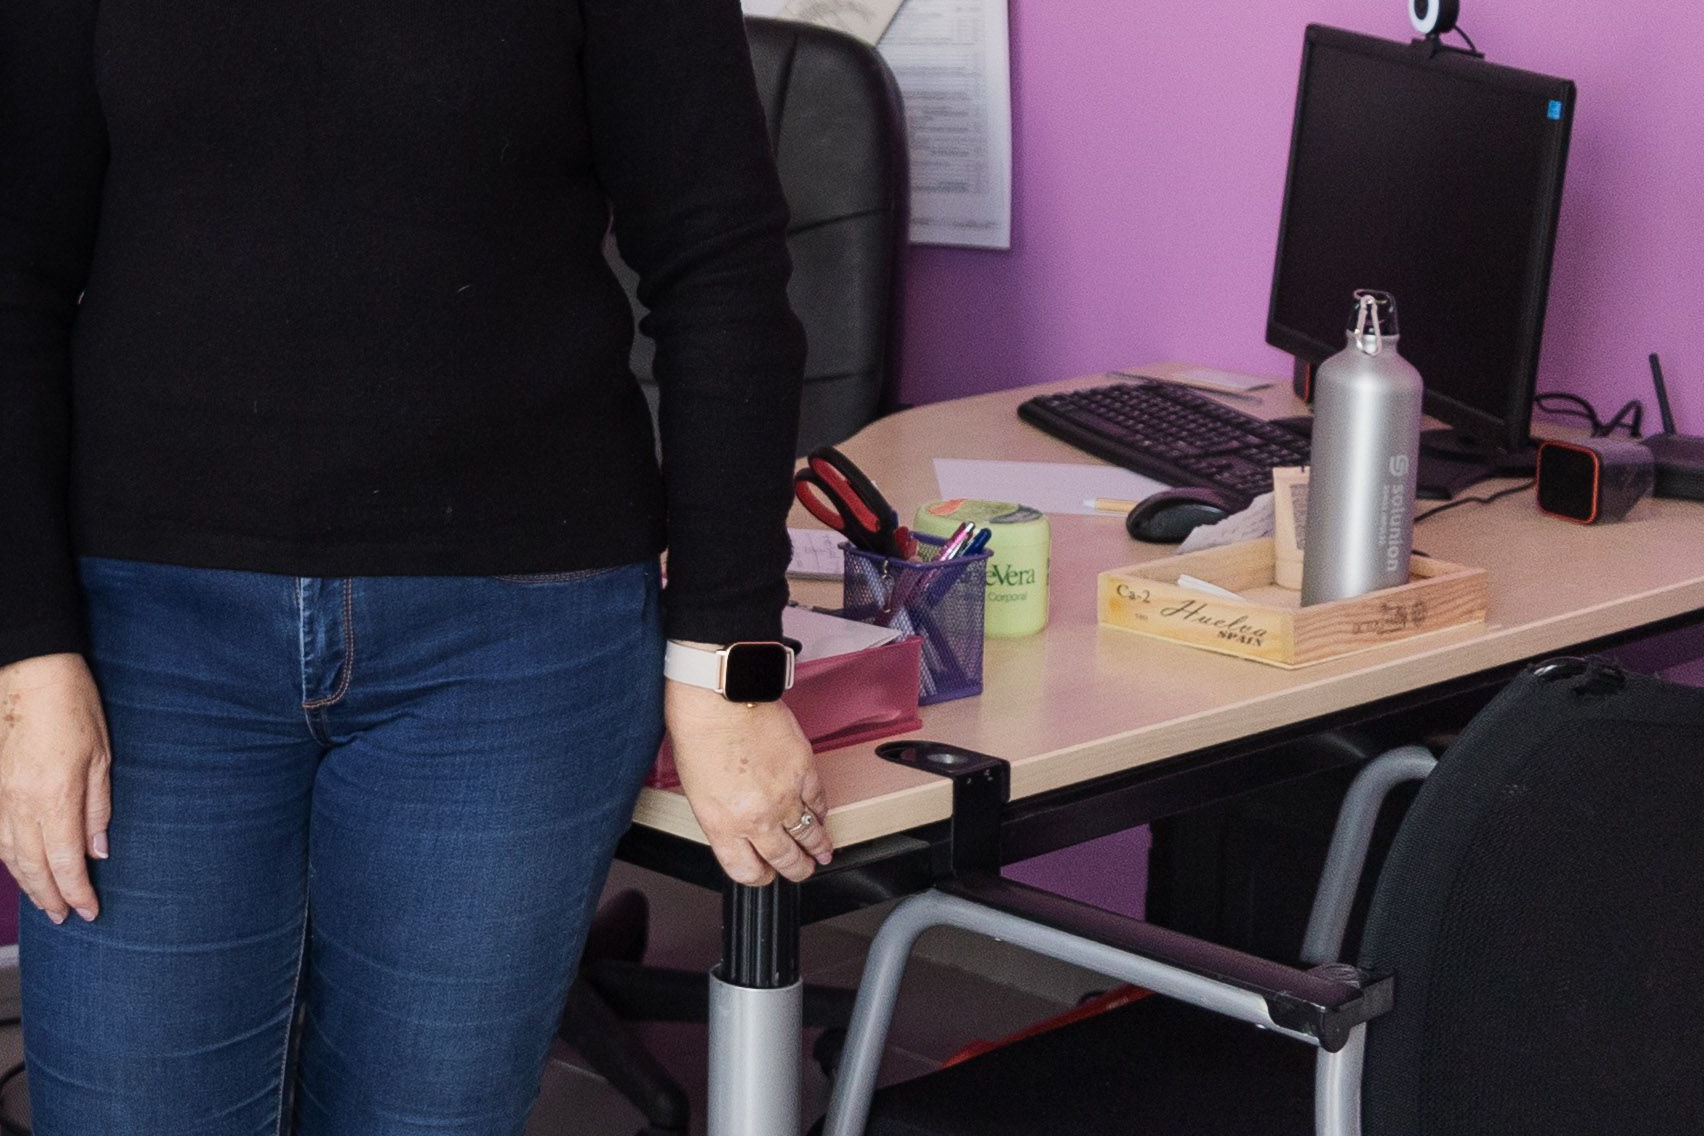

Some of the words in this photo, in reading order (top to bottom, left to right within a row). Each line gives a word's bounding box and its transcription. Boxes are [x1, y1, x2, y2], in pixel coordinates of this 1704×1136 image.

[1116, 583, 1151, 604] Ca-2
[1159, 599, 1268, 638] Huelva
[1216, 629, 1265, 647] SPAIN
